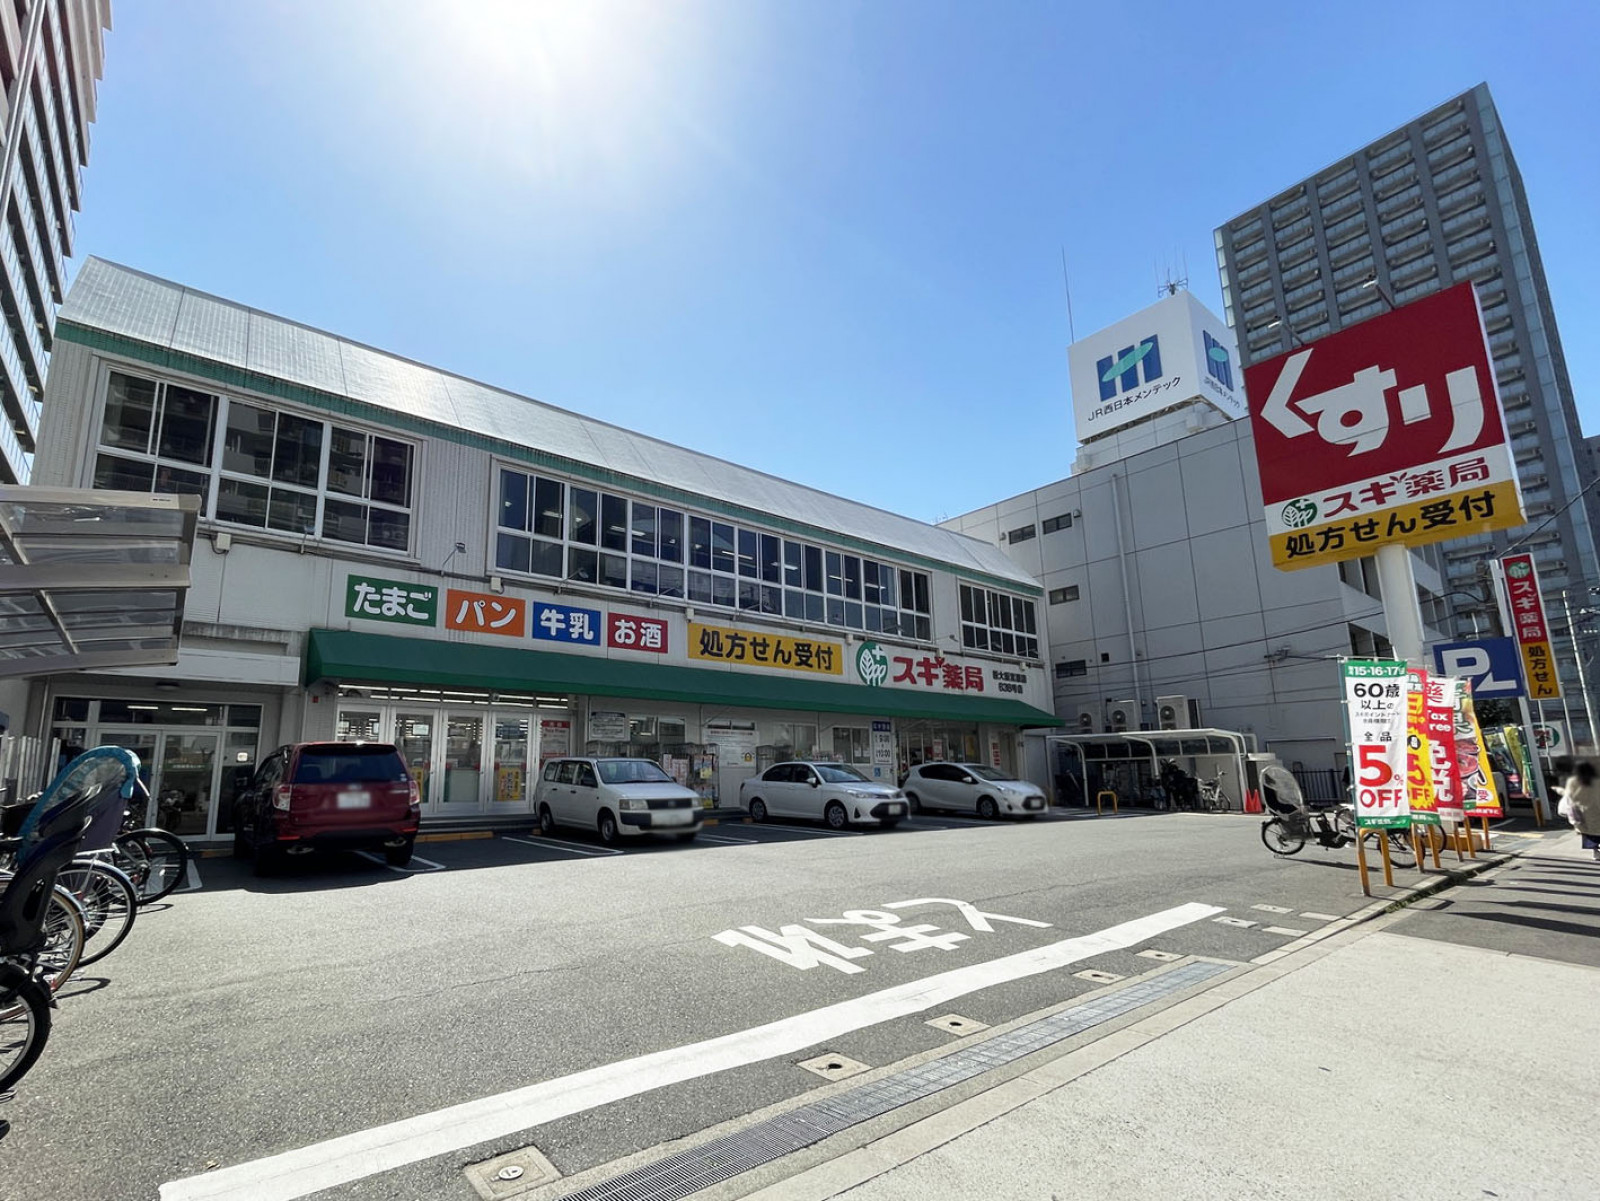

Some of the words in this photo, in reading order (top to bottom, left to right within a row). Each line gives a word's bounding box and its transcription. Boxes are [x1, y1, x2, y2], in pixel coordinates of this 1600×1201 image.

[1087, 376, 1181, 422] JR西日本メンテック
[1260, 347, 1486, 458] くすり
[1323, 456, 1490, 519] スギ薬局
[1285, 490, 1496, 559] 処方せん受付
[353, 582, 432, 620] たまご
[455, 599, 517, 628] パン
[1512, 581, 1542, 639] スギ薬局
[540, 608, 594, 641] 牛乳
[614, 618, 662, 649] お酒
[699, 628, 834, 671] 処方せん受付
[1441, 647, 1491, 677] P
[893, 656, 985, 692] スギ薬局
[1528, 645, 1553, 695] 処方せん
[1354, 682, 1400, 699] 60歳
[1361, 699, 1394, 710] 以上の
[1429, 711, 1448, 721] ax
[1429, 723, 1452, 732] ree
[1360, 788, 1403, 808] OFF
